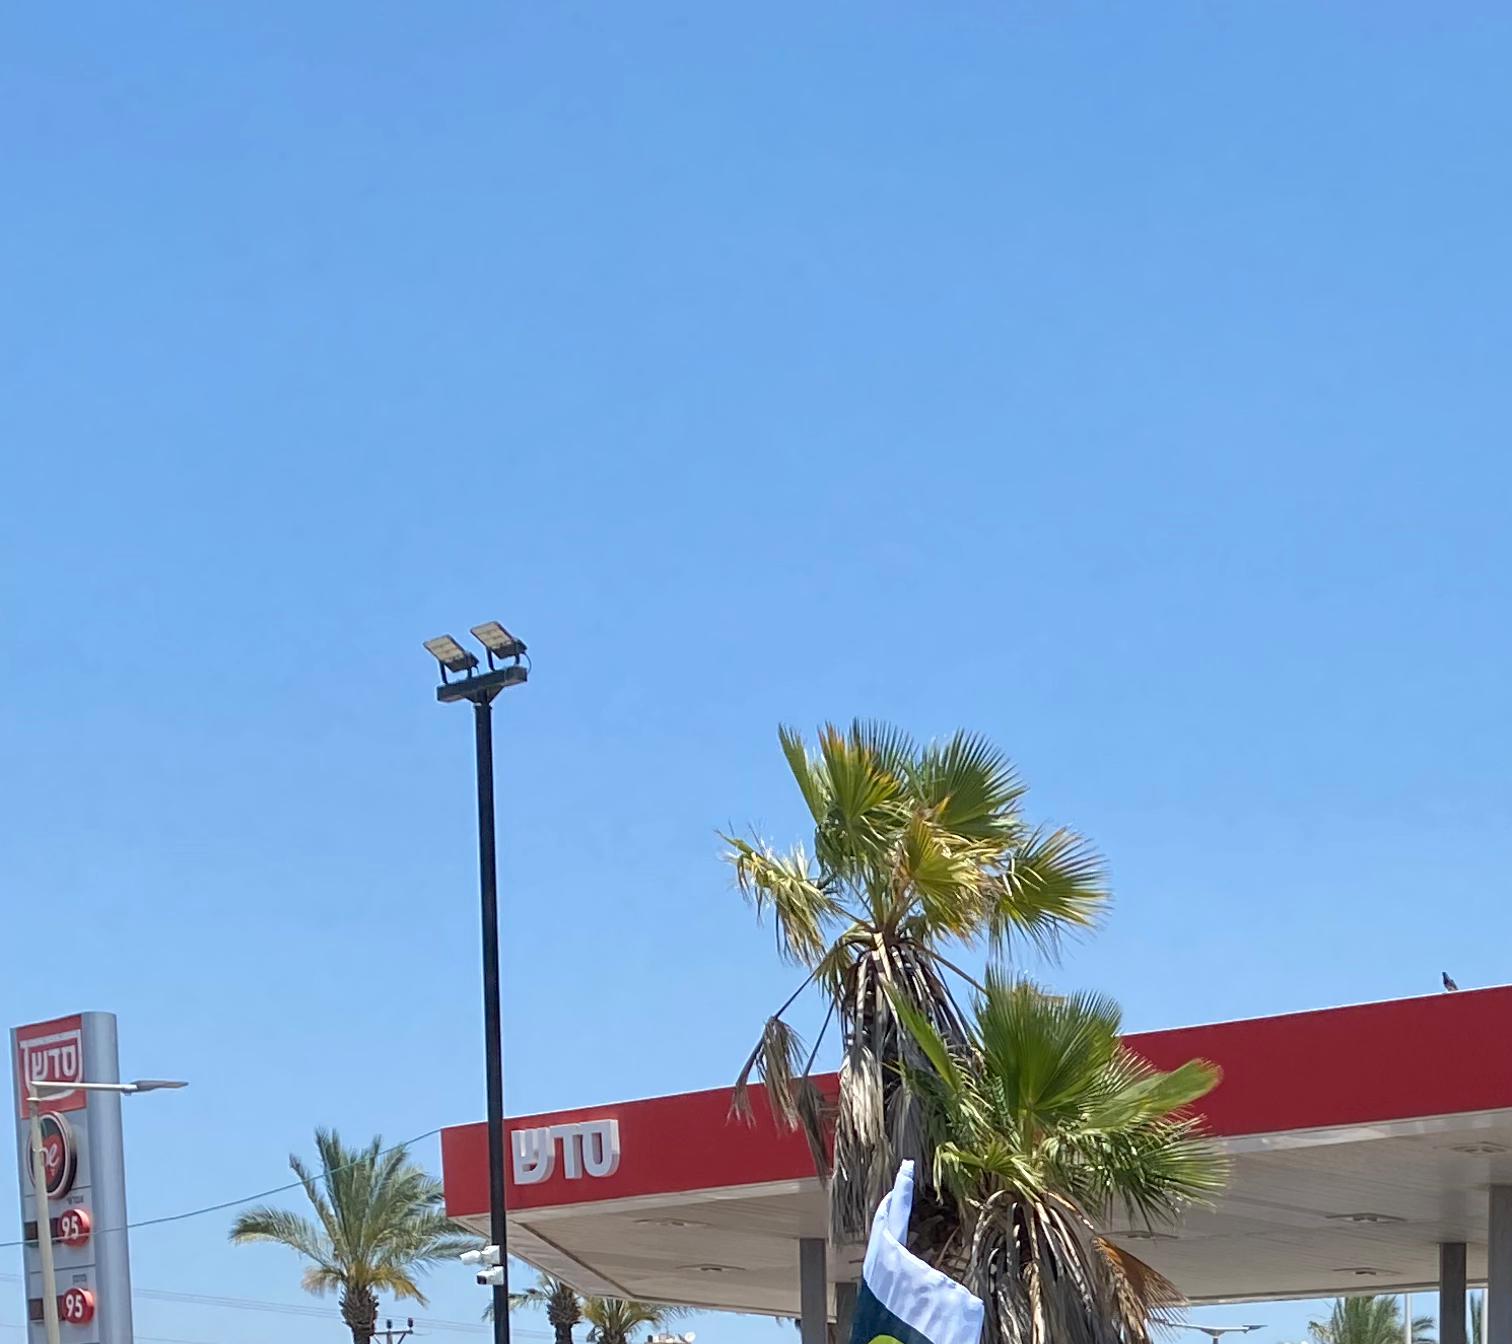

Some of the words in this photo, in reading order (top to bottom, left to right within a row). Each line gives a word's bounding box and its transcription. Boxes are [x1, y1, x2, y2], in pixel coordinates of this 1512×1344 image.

[32, 1045, 77, 1081] סדש
[511, 1119, 620, 1185] סדש
[61, 1217, 79, 1240] 95
[65, 1295, 83, 1318] 95
